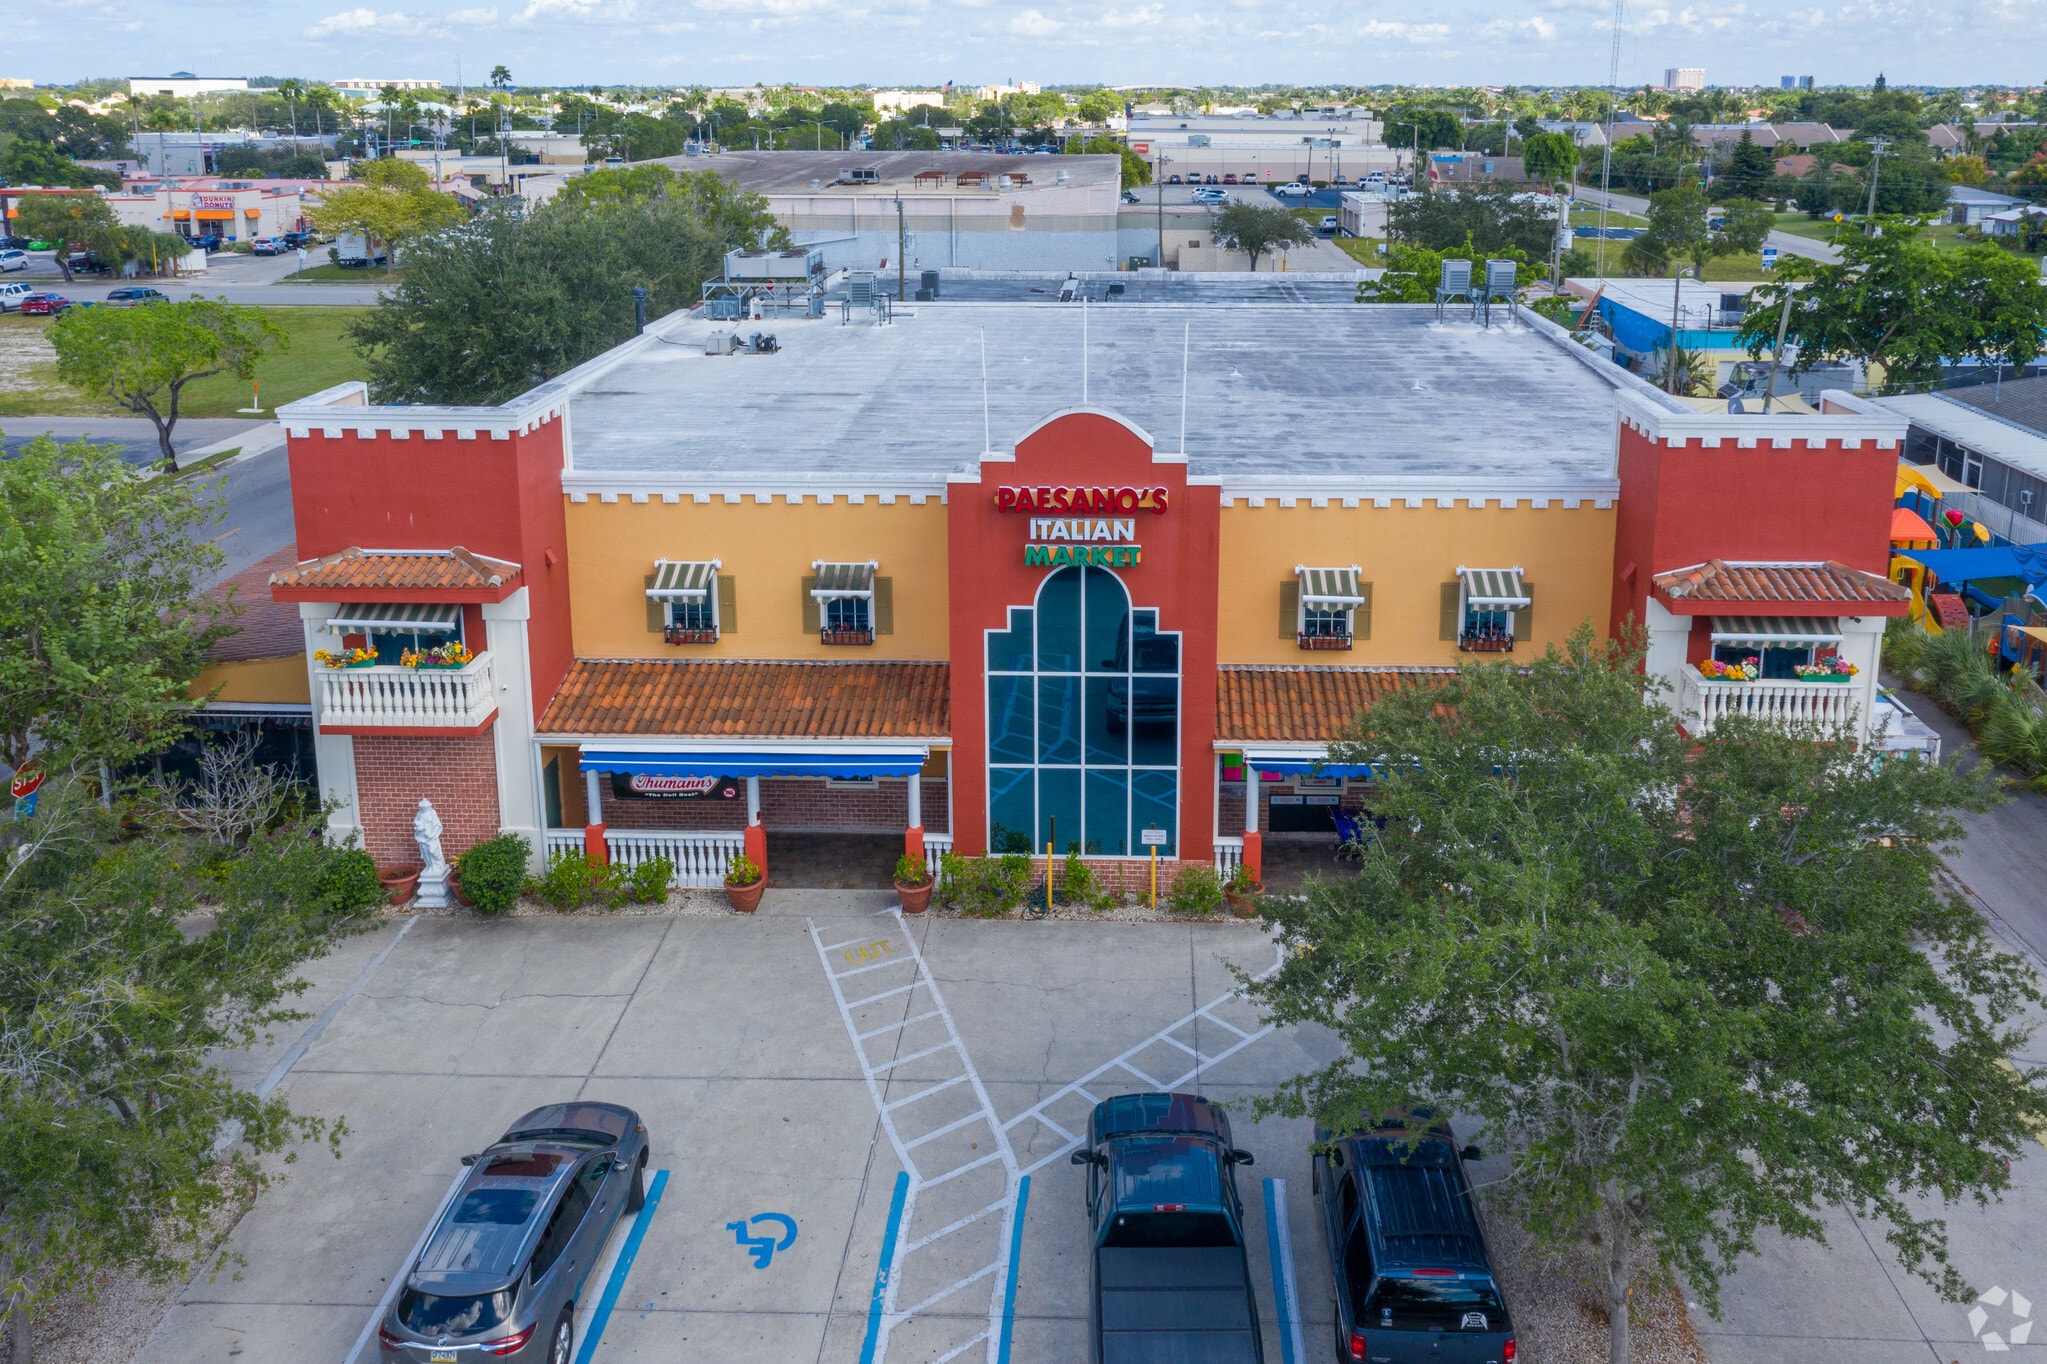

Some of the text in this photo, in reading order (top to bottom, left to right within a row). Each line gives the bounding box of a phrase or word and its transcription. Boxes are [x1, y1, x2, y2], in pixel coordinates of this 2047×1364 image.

[997, 485, 1168, 515] PAESANO'S
[1029, 518, 1135, 541] ITALIAN
[1024, 544, 1141, 567] MARKET
